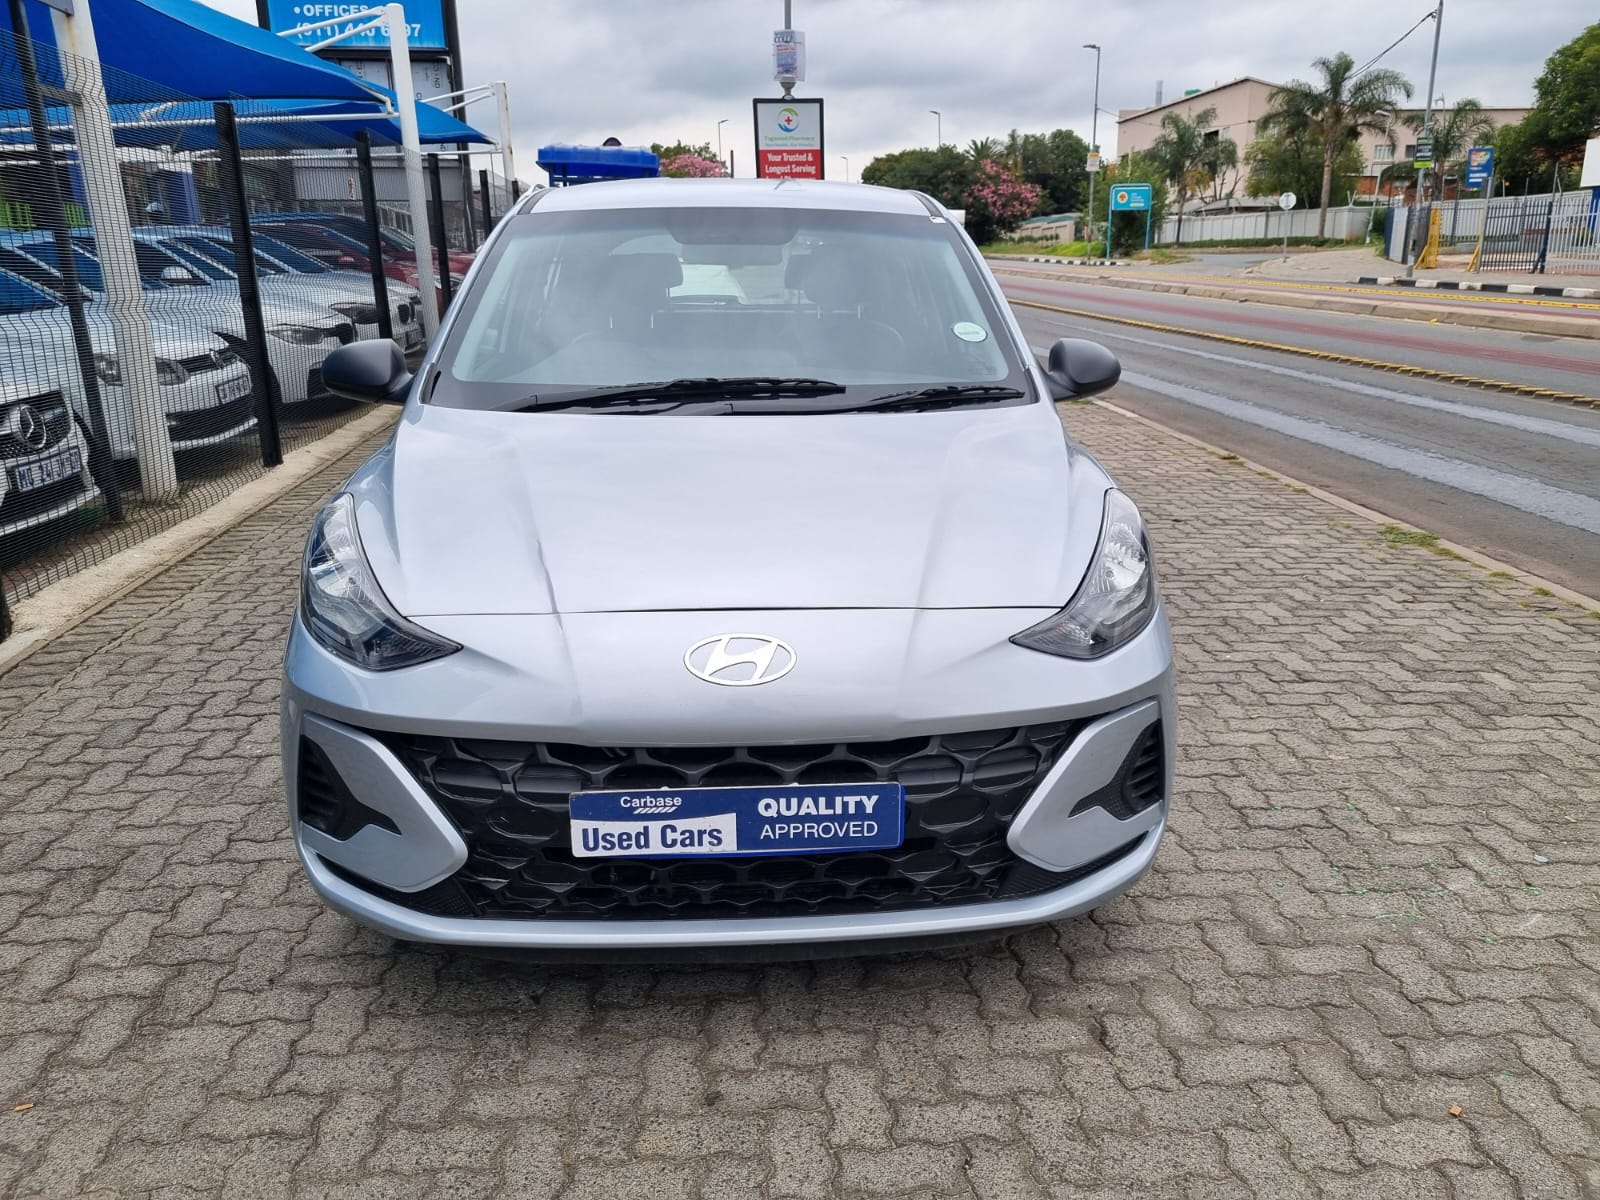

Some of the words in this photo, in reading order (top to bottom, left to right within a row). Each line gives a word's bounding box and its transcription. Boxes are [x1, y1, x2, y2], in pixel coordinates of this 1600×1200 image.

[303, 4, 369, 17] OFFICES
[767, 152, 782, 162] Your
[782, 152, 807, 162] Trusted
[807, 153, 813, 162] &
[764, 164, 791, 175] Longest
[791, 164, 816, 174] Serving
[620, 795, 682, 808] Carbase
[757, 794, 879, 818] QUALITY
[760, 820, 878, 840] APPROVED
[582, 825, 650, 852] Used
[660, 823, 723, 849] Cars
